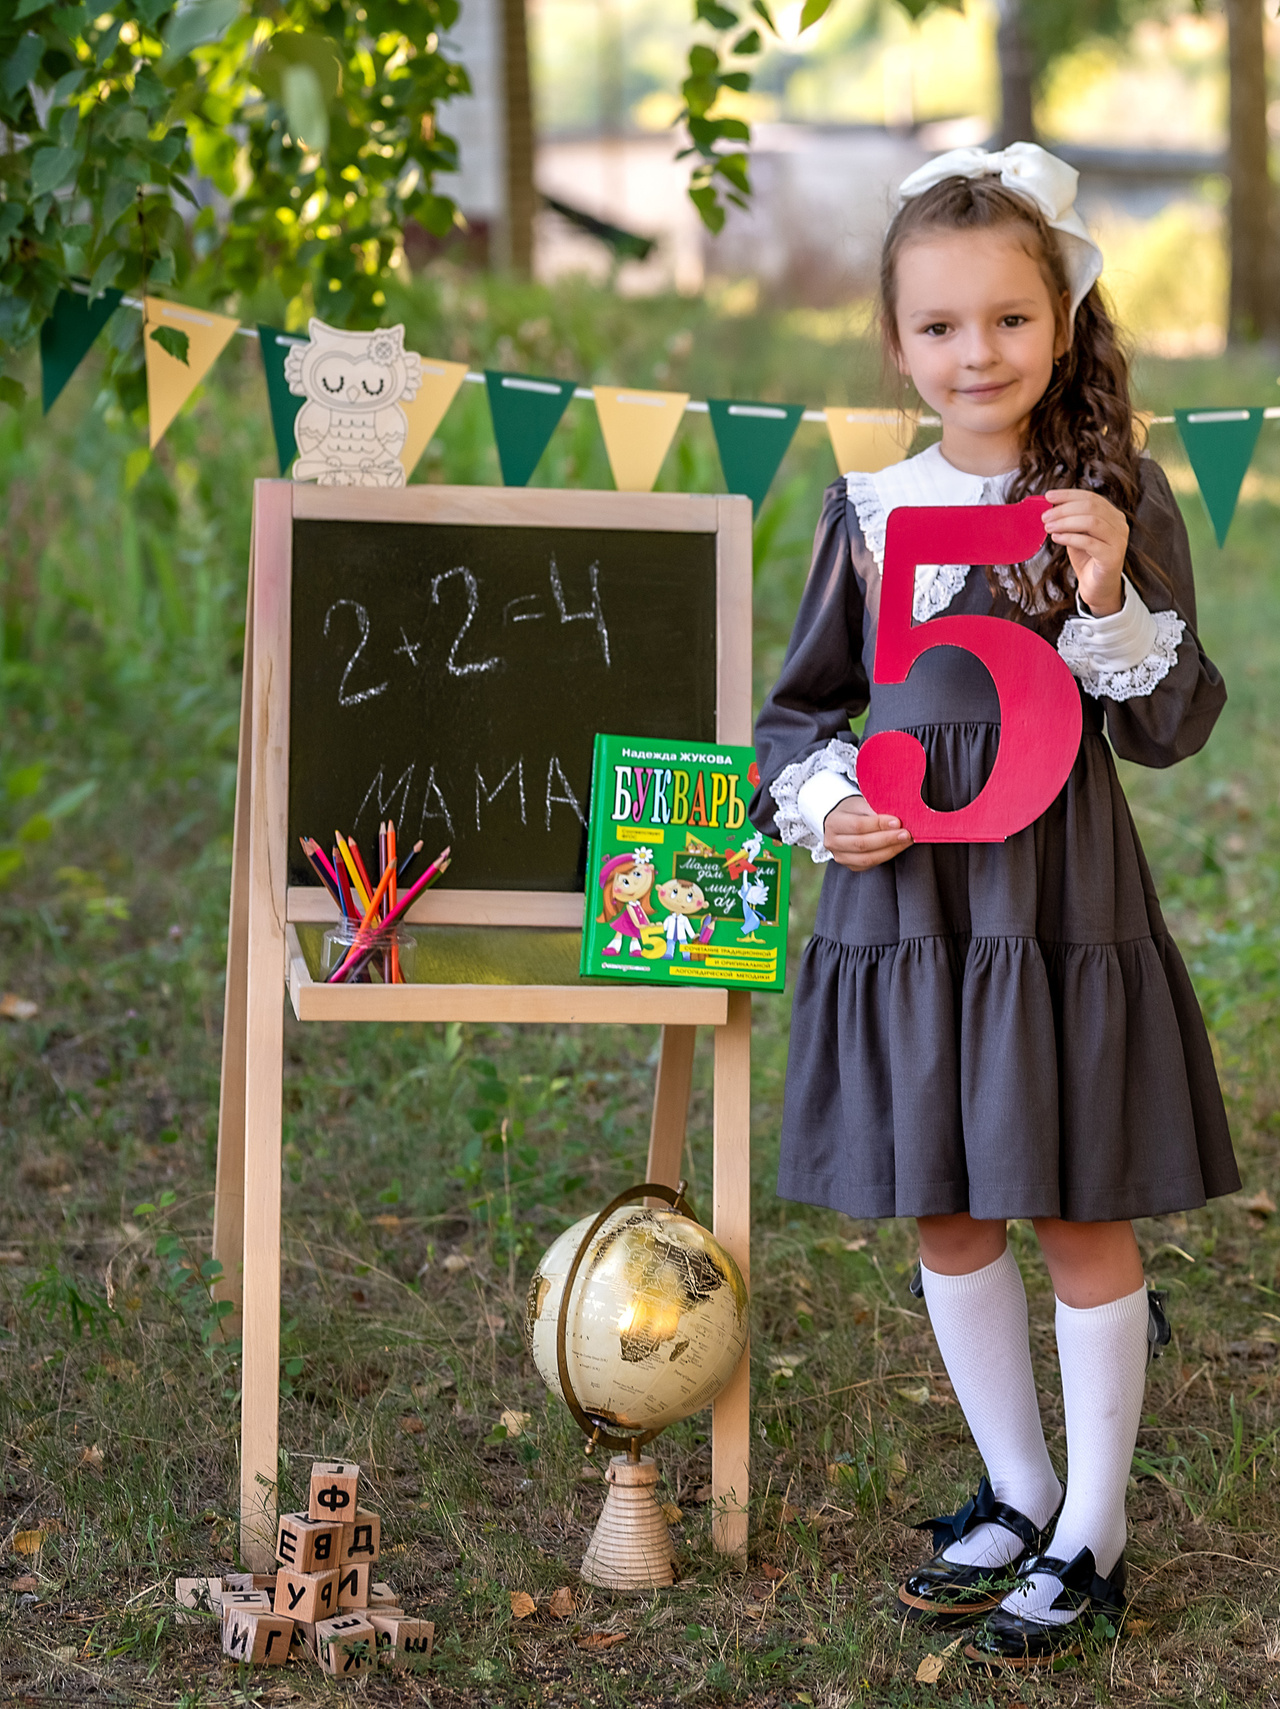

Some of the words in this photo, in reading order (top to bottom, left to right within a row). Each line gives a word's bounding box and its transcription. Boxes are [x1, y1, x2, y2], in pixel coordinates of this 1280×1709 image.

[856, 495, 1083, 843] 5
[622, 747, 677, 761] Надежда
[680, 752, 733, 765] ЖУКОВА
[353, 753, 589, 840] МАМА
[611, 765, 747, 830] БУКВАРЬ
[704, 884, 738, 898] мир
[714, 897, 736, 914] ау
[640, 926, 668, 960] 5
[684, 945, 719, 954] СОЧЕТАНИЕ
[721, 948, 772, 957] ТРАДИЦИОННОЙ
[675, 968, 733, 978] ЛОГОПЕДИЧЕСКОЙ
[721, 960, 771, 969] ОРИГИНАЛЬНОЙ
[317, 1484, 350, 1512] Ф
[347, 1524, 375, 1558] Д
[287, 1582, 306, 1611] У
